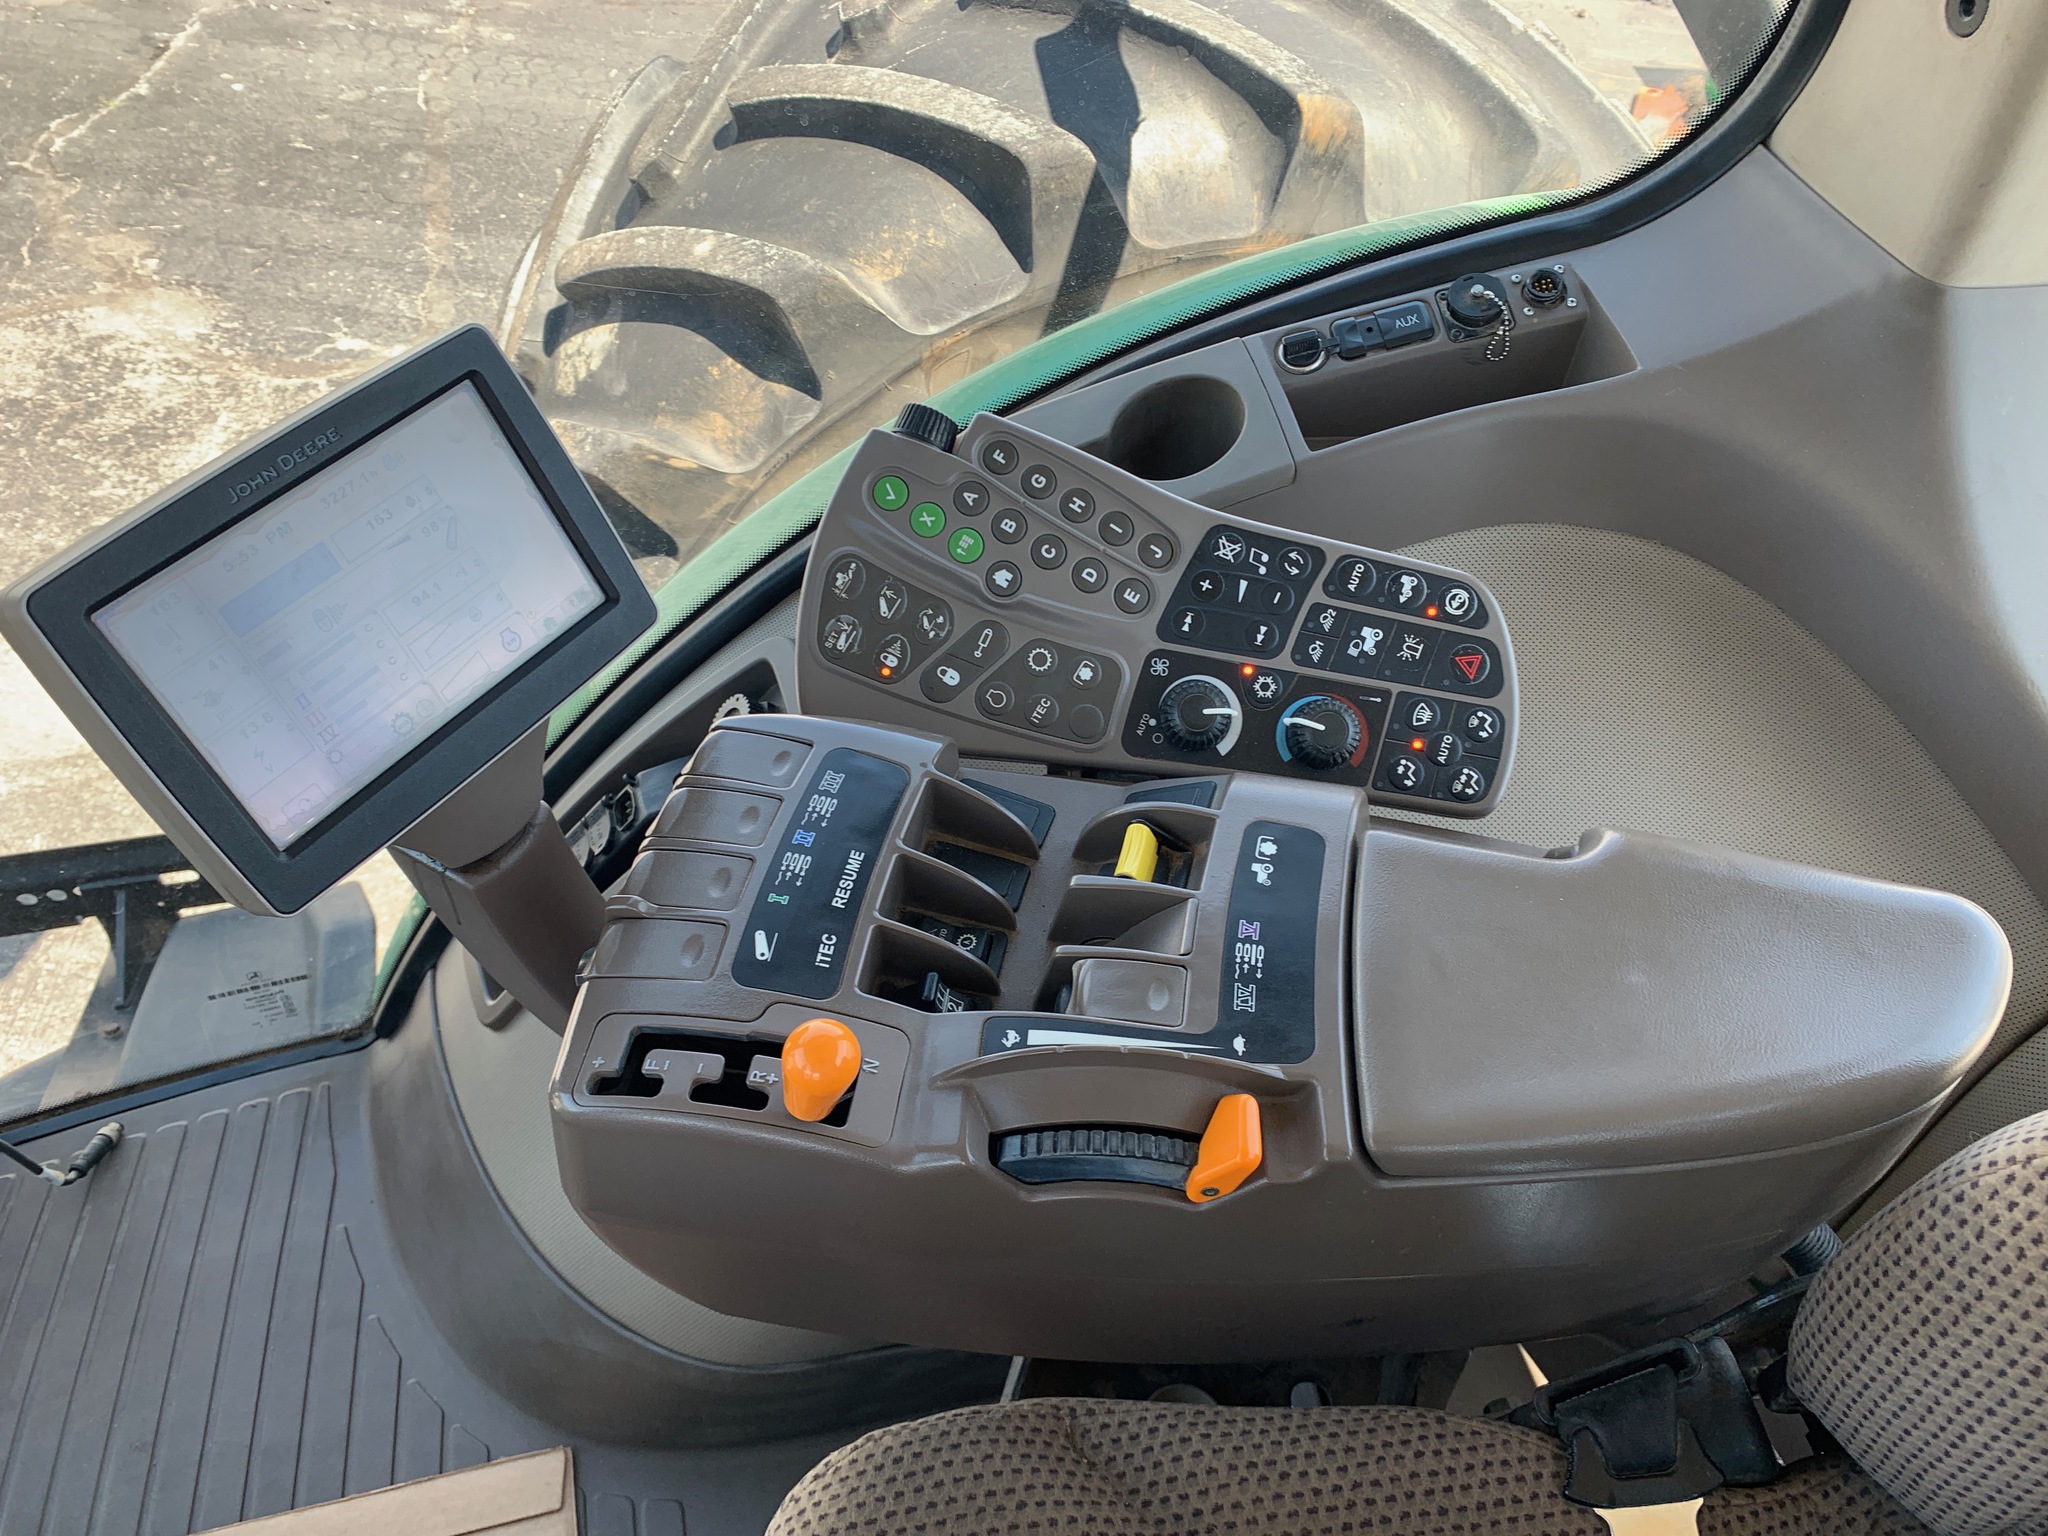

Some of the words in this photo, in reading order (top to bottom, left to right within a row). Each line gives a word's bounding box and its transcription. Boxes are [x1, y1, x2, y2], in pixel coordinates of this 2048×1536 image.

[1395, 313, 1420, 329] AUX
[228, 465, 279, 505] JOHN
[277, 427, 342, 472] DEERE
[992, 449, 1007, 465] F
[1031, 473, 1047, 489] G
[962, 491, 979, 507] A
[1068, 496, 1086, 514] H
[365, 508, 394, 531] 163
[1000, 518, 1017, 534] B
[265, 521, 294, 545] PM
[1040, 544, 1057, 560] C
[1149, 543, 1163, 559] J
[1080, 567, 1098, 584] D
[1347, 563, 1365, 592] AUTO
[150, 592, 182, 617] 163
[411, 581, 442, 608] 94.1
[1123, 587, 1141, 604] E
[824, 631, 840, 649] SET
[209, 652, 229, 672] 41
[239, 711, 274, 740] 13.8
[315, 722, 341, 746] IV
[1136, 713, 1150, 736] AUTO
[1437, 734, 1453, 765] AUTO
[818, 769, 846, 794] III
[830, 849, 866, 909] RESUME
[814, 932, 838, 968] iTEC
[863, 1058, 881, 1074] N
